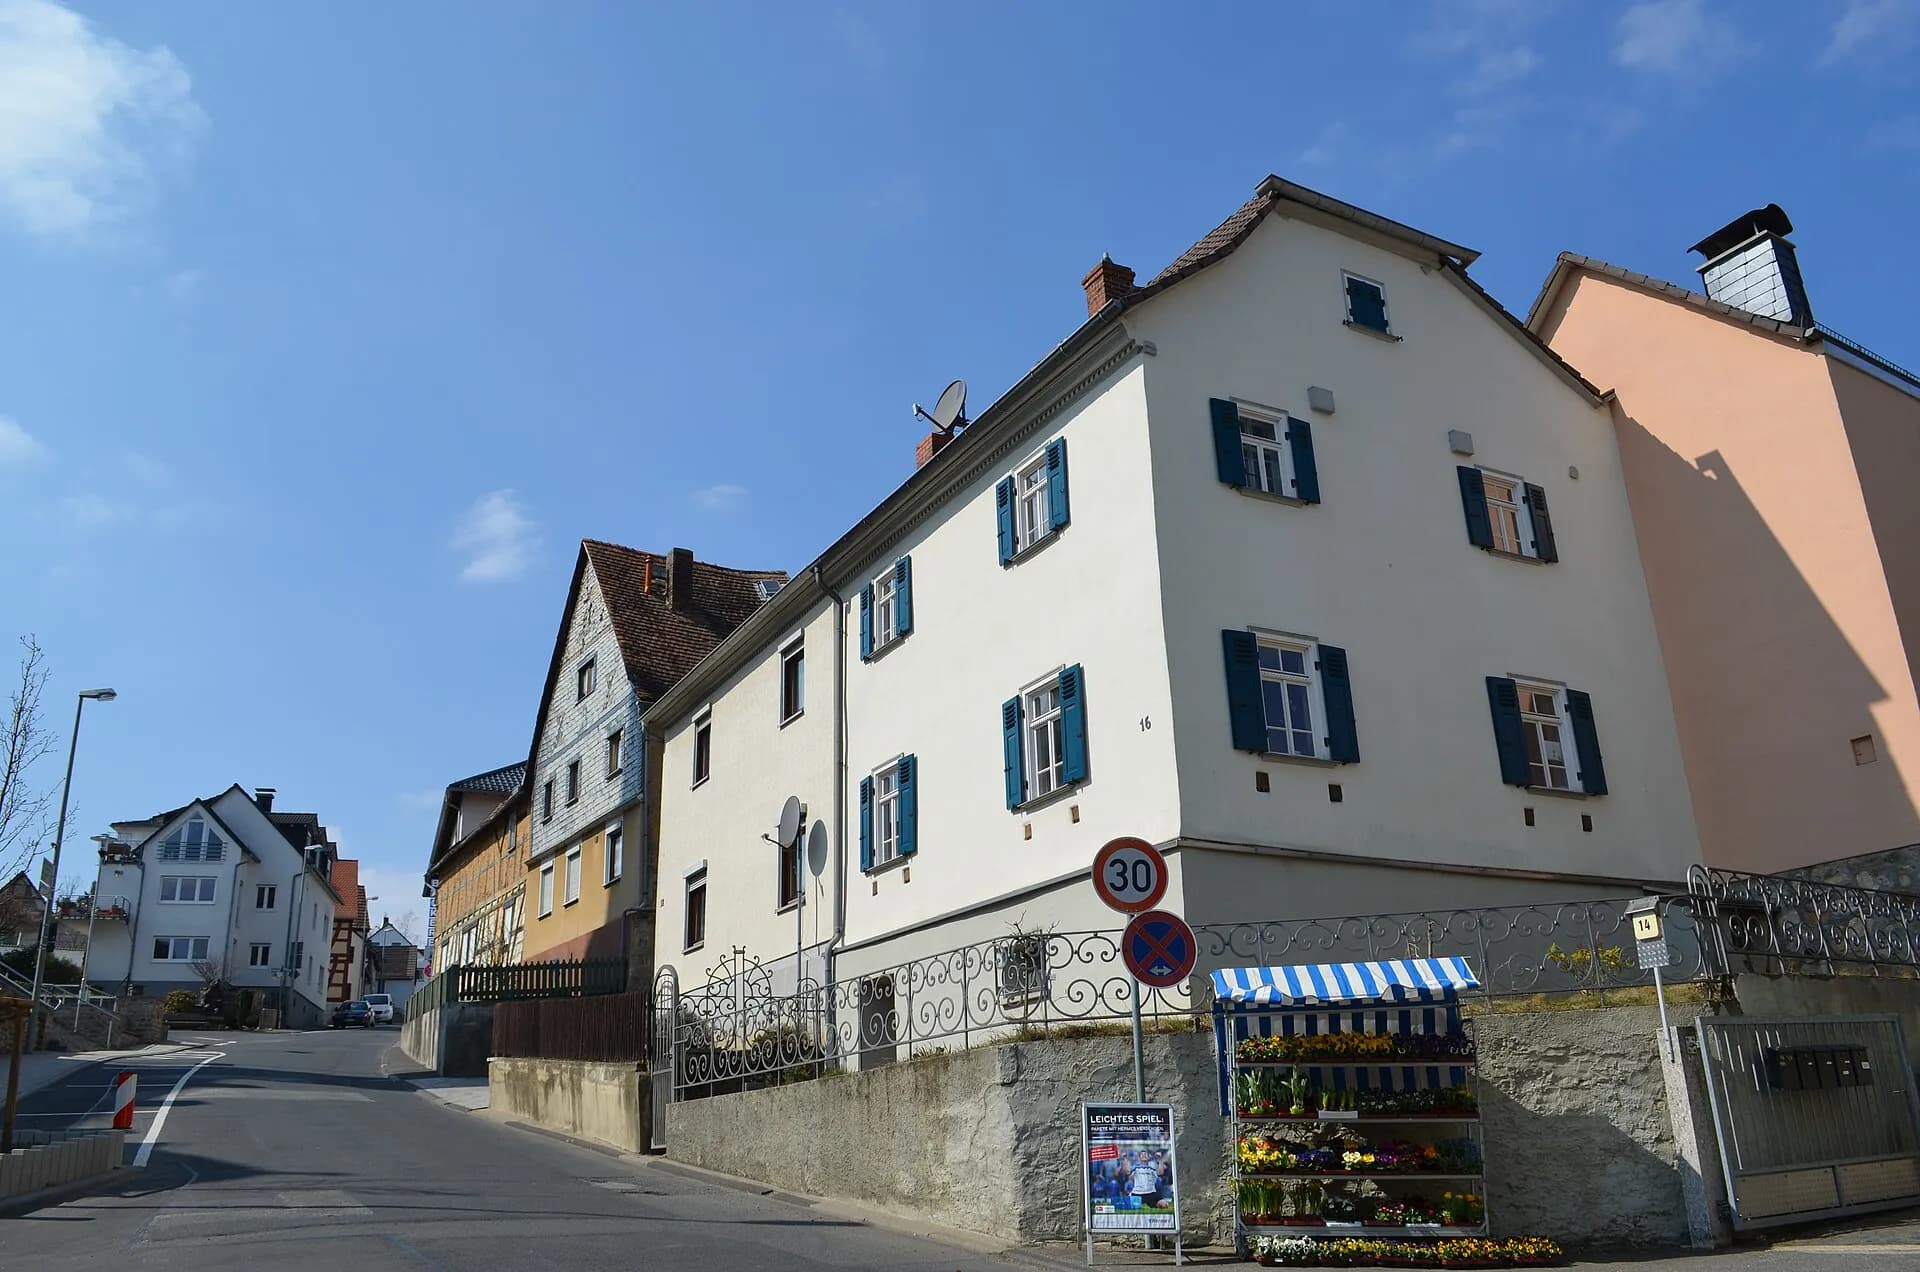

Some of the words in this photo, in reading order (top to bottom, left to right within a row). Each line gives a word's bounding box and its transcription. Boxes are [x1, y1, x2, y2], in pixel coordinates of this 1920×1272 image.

[1139, 715, 1152, 732] 16
[1109, 858, 1152, 893] 30
[1638, 919, 1651, 931] 14
[1090, 1115, 1134, 1124] LEICHTES
